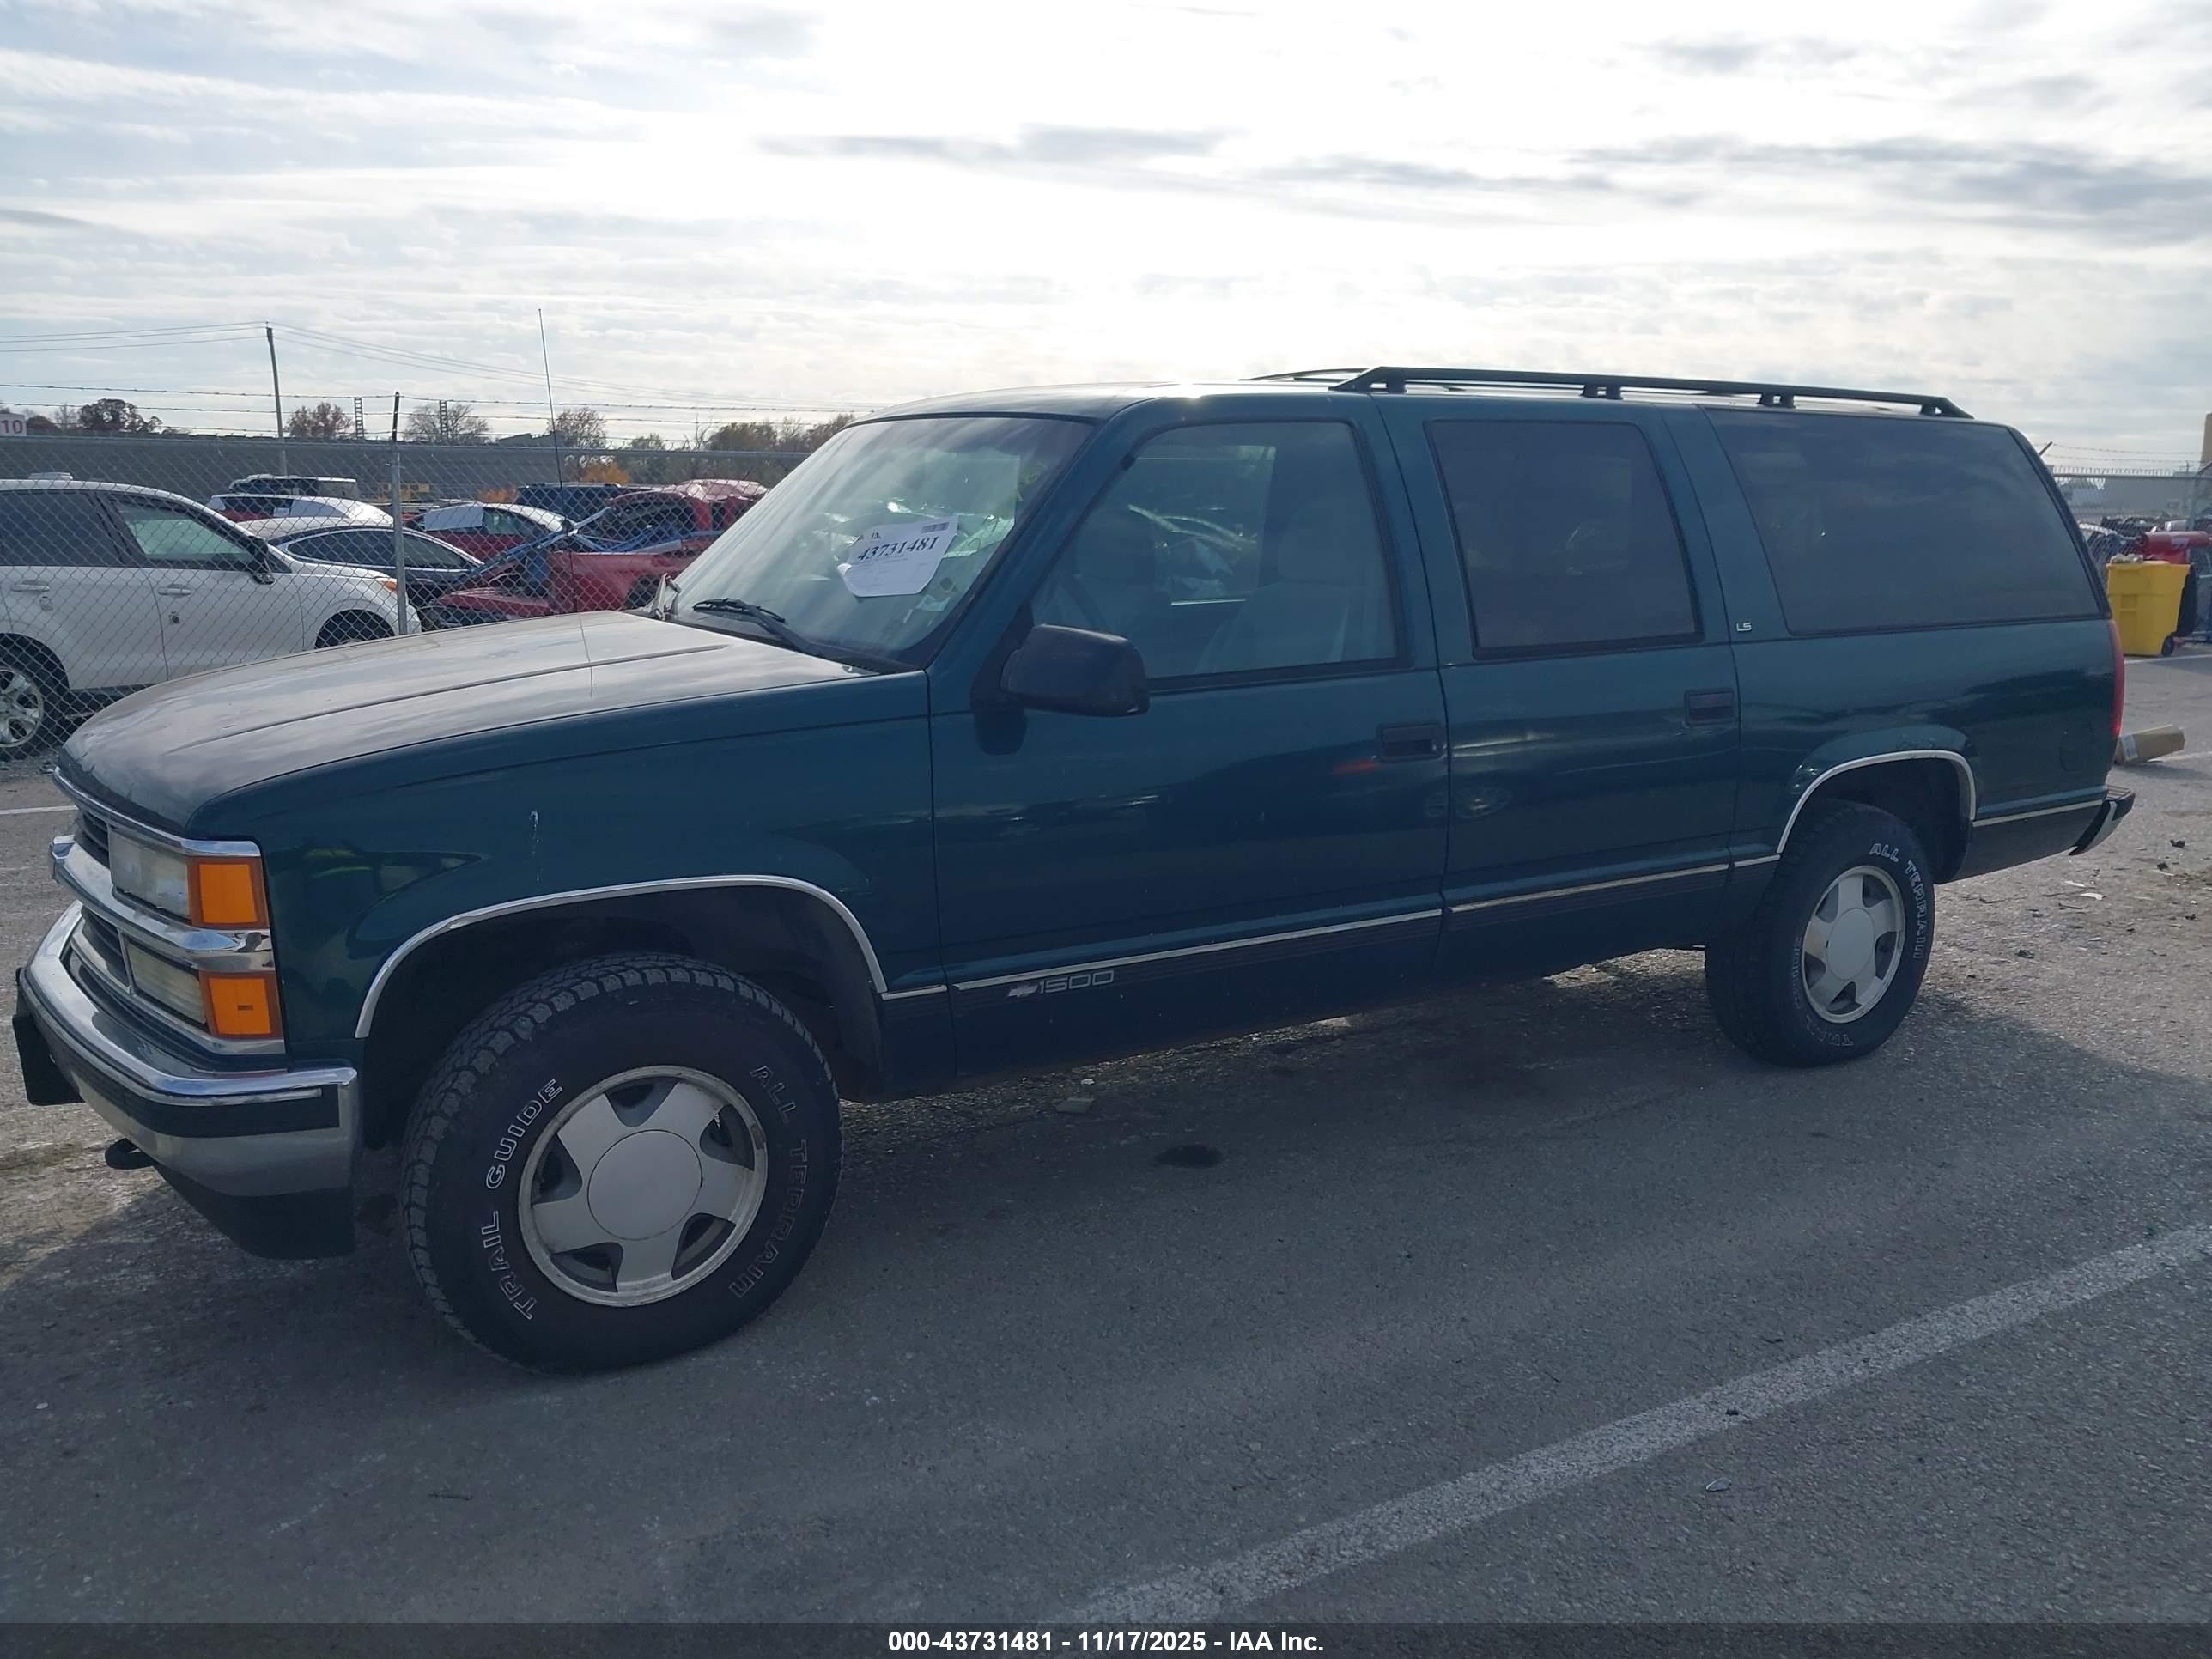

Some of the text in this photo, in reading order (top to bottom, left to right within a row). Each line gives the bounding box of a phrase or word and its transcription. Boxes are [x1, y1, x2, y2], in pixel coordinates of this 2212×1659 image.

[858, 536, 939, 561] 43731481
[1736, 622, 1752, 632] LS
[1869, 843, 1928, 961] ALL TERRAIN
[1039, 970, 1115, 994] 1500
[482, 1079, 562, 1320] TRAIL GUIDE
[729, 1066, 808, 1298] ALL TERRAIN
